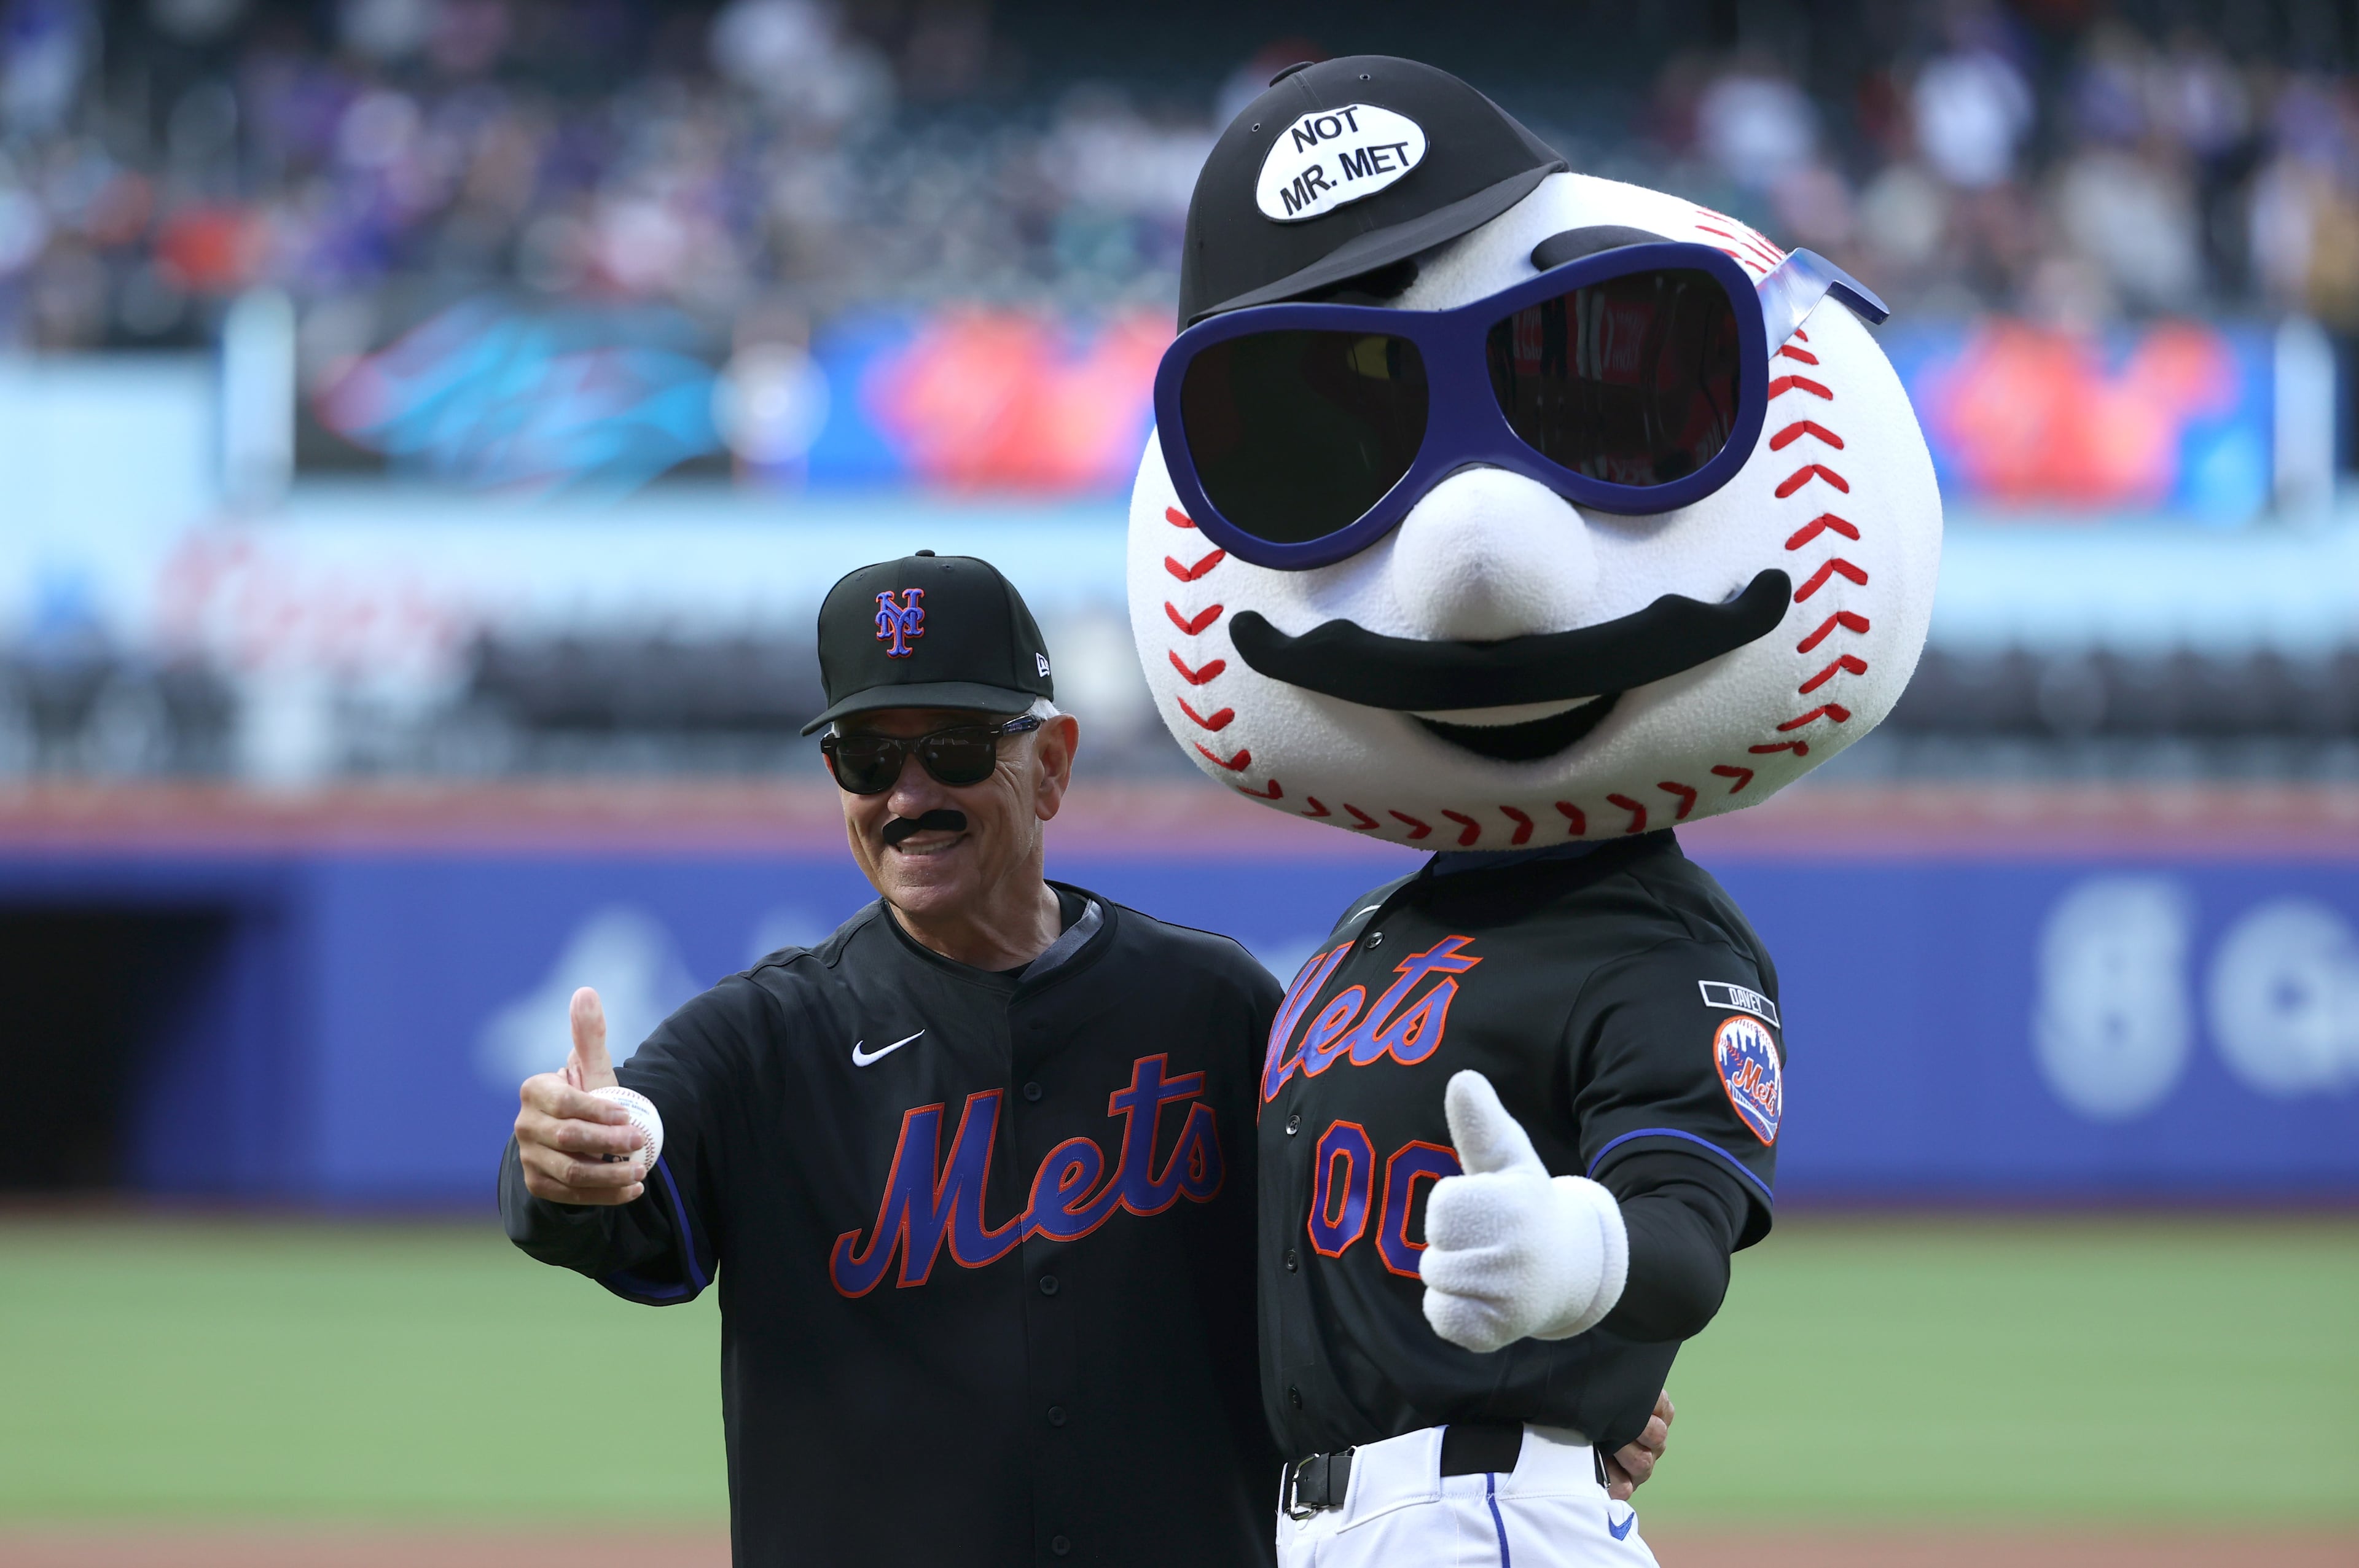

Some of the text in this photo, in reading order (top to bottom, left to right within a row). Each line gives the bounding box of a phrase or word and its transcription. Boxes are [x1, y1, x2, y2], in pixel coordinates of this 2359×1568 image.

[1291, 106, 1359, 154] NOT
[1280, 141, 1410, 216] MR. MET
[1728, 987, 1762, 1013] DAVEY
[1732, 1056, 1777, 1116] Mets
[829, 1052, 1226, 1298] Mets
[1307, 1119, 1463, 1279] 00
